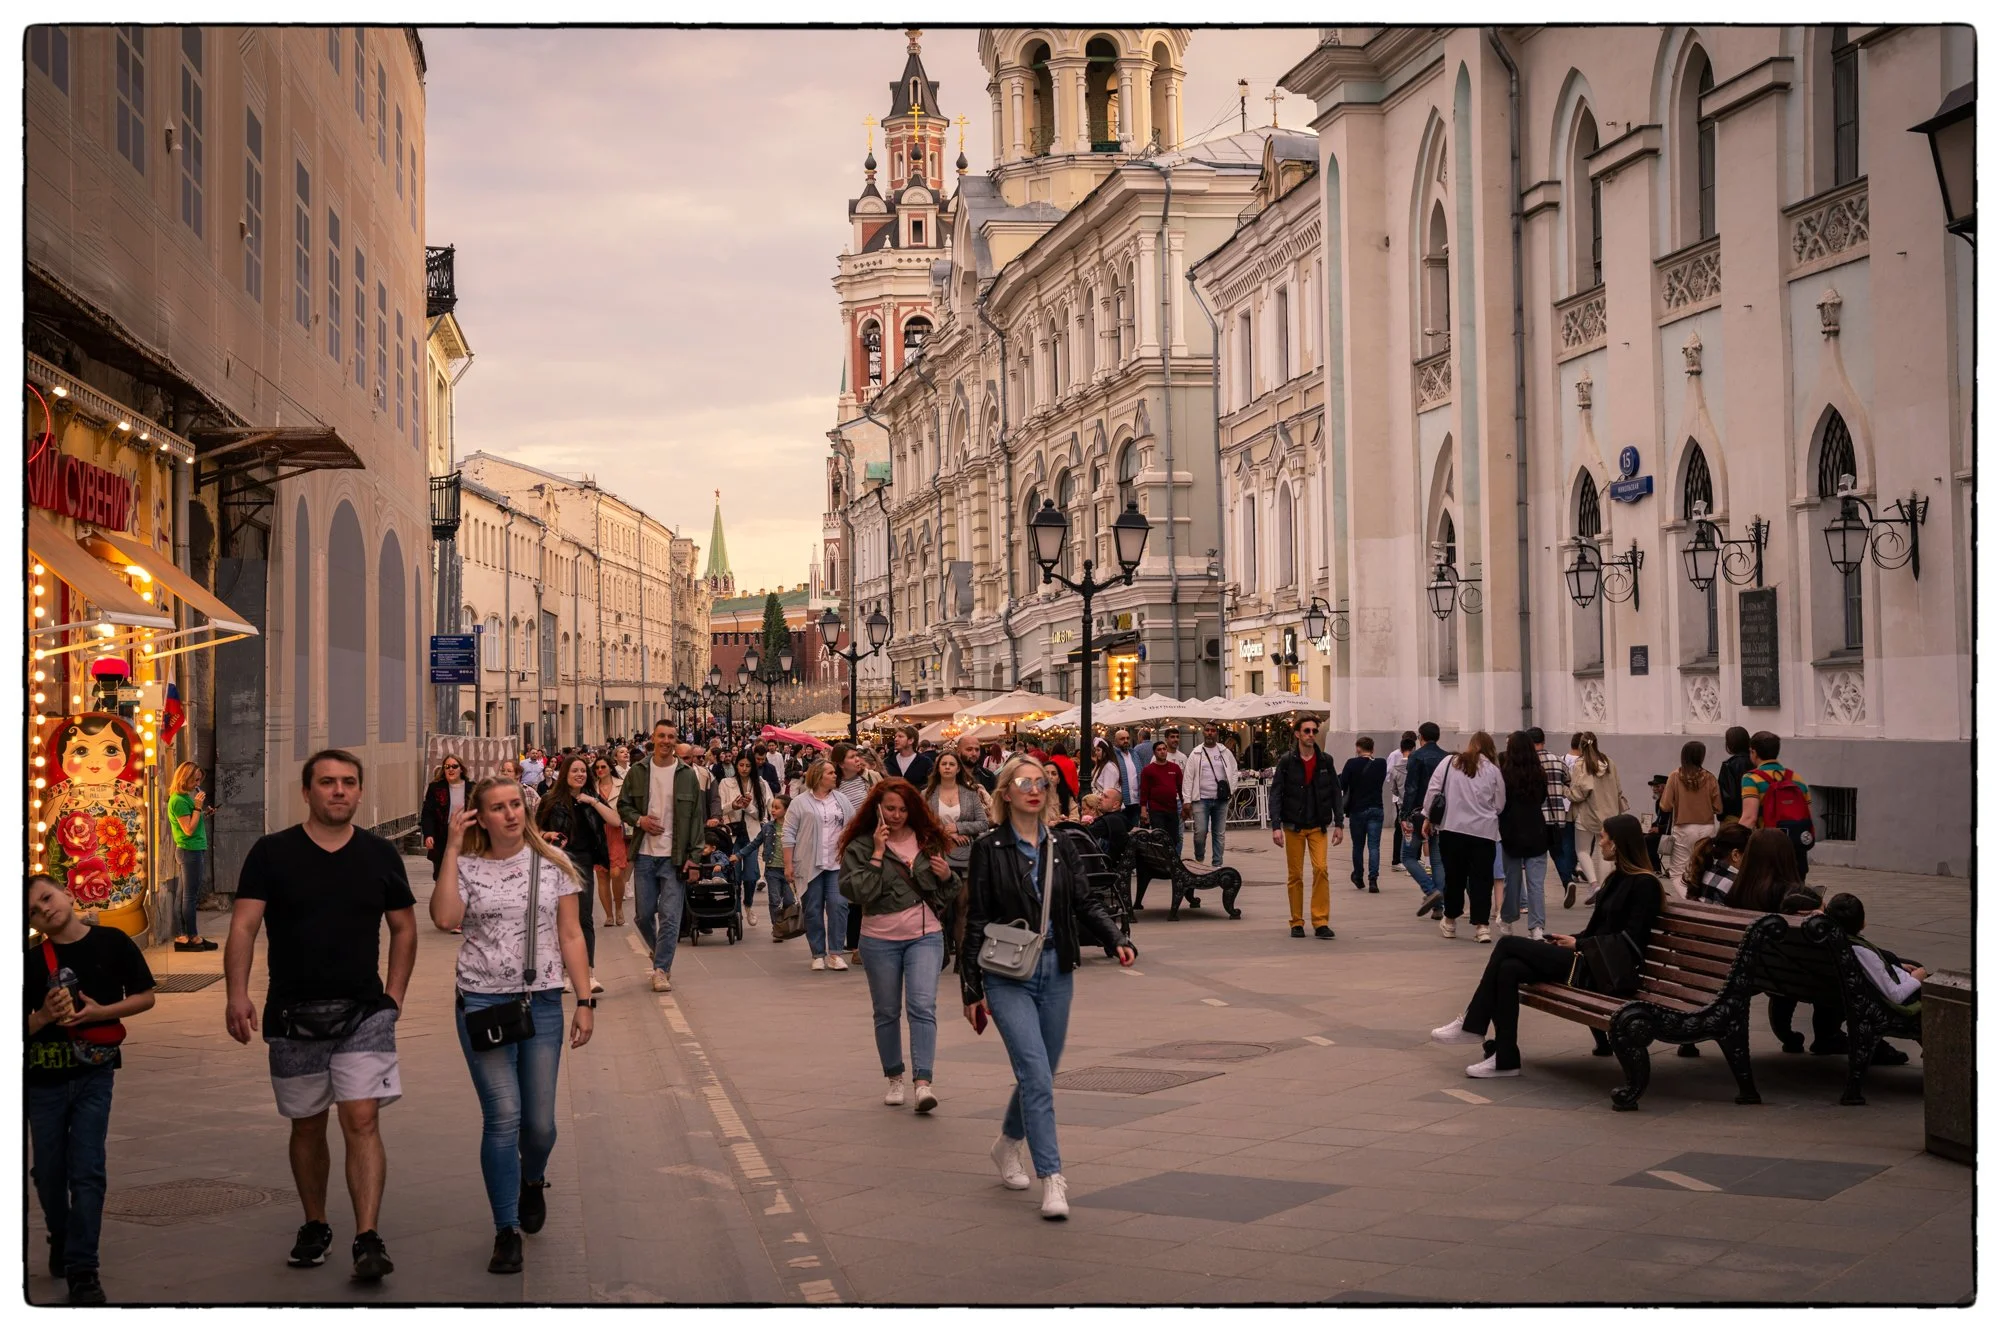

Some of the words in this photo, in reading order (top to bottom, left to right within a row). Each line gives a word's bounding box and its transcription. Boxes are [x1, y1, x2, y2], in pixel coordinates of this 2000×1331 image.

[1622, 452, 1631, 468] 15
[65, 455, 131, 531] СУВЕНИР
[501, 871, 523, 883] WORLD
